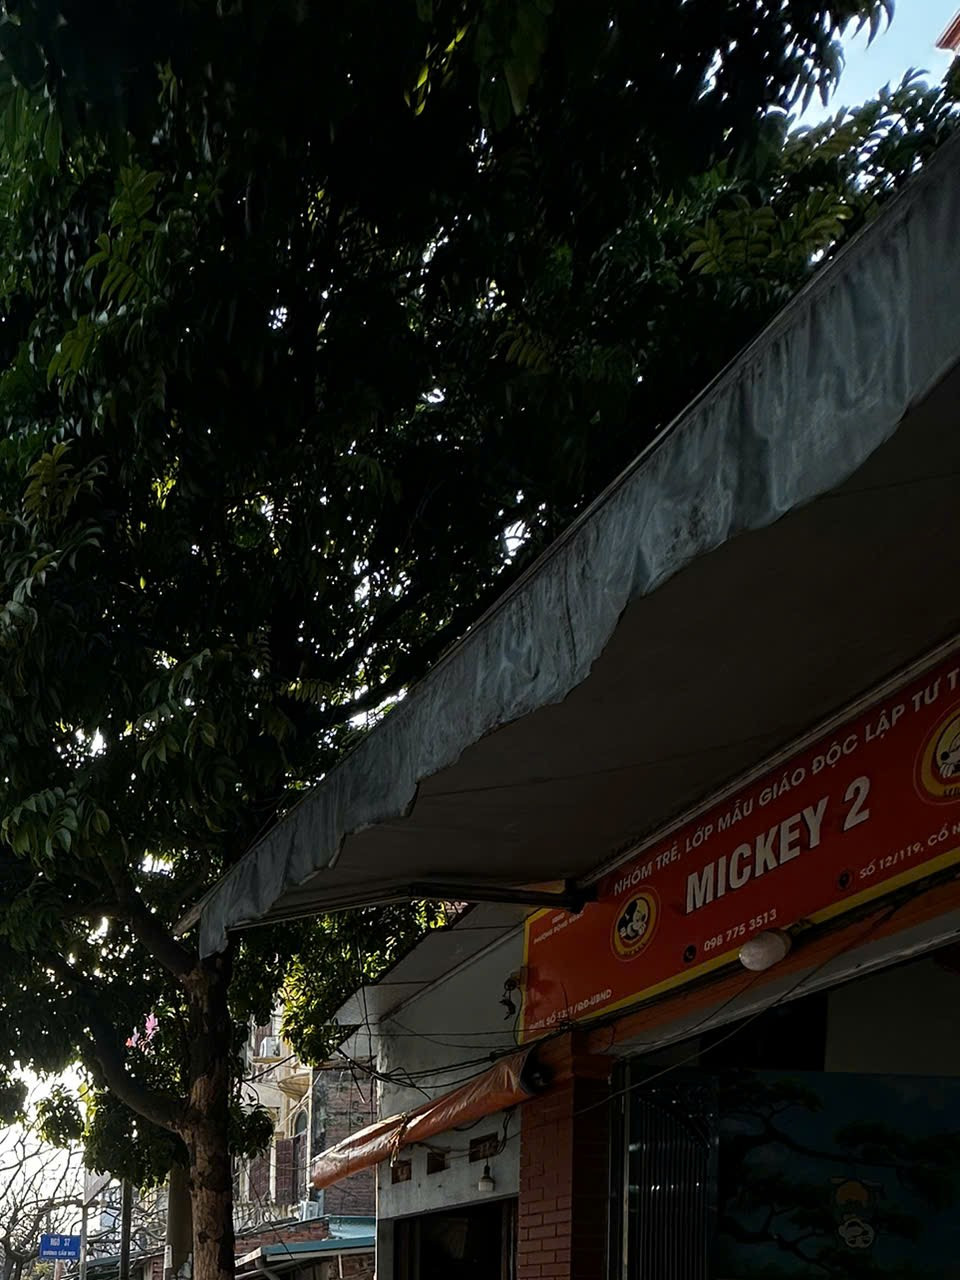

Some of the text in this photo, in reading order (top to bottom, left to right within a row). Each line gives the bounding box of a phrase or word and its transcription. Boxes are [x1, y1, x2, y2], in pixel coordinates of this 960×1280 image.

[613, 861, 654, 897] NHÓM
[685, 823, 714, 853] LỚP
[718, 798, 754, 833] MẪU
[759, 768, 806, 807] GIÁO
[811, 733, 858, 775] ĐỘC
[865, 703, 906, 743] LẬP
[911, 675, 942, 713] TƯ
[947, 667, 960, 691] T
[686, 775, 871, 915] MICKEY 2
[704, 933, 724, 952] 098
[749, 908, 777, 931] 3513
